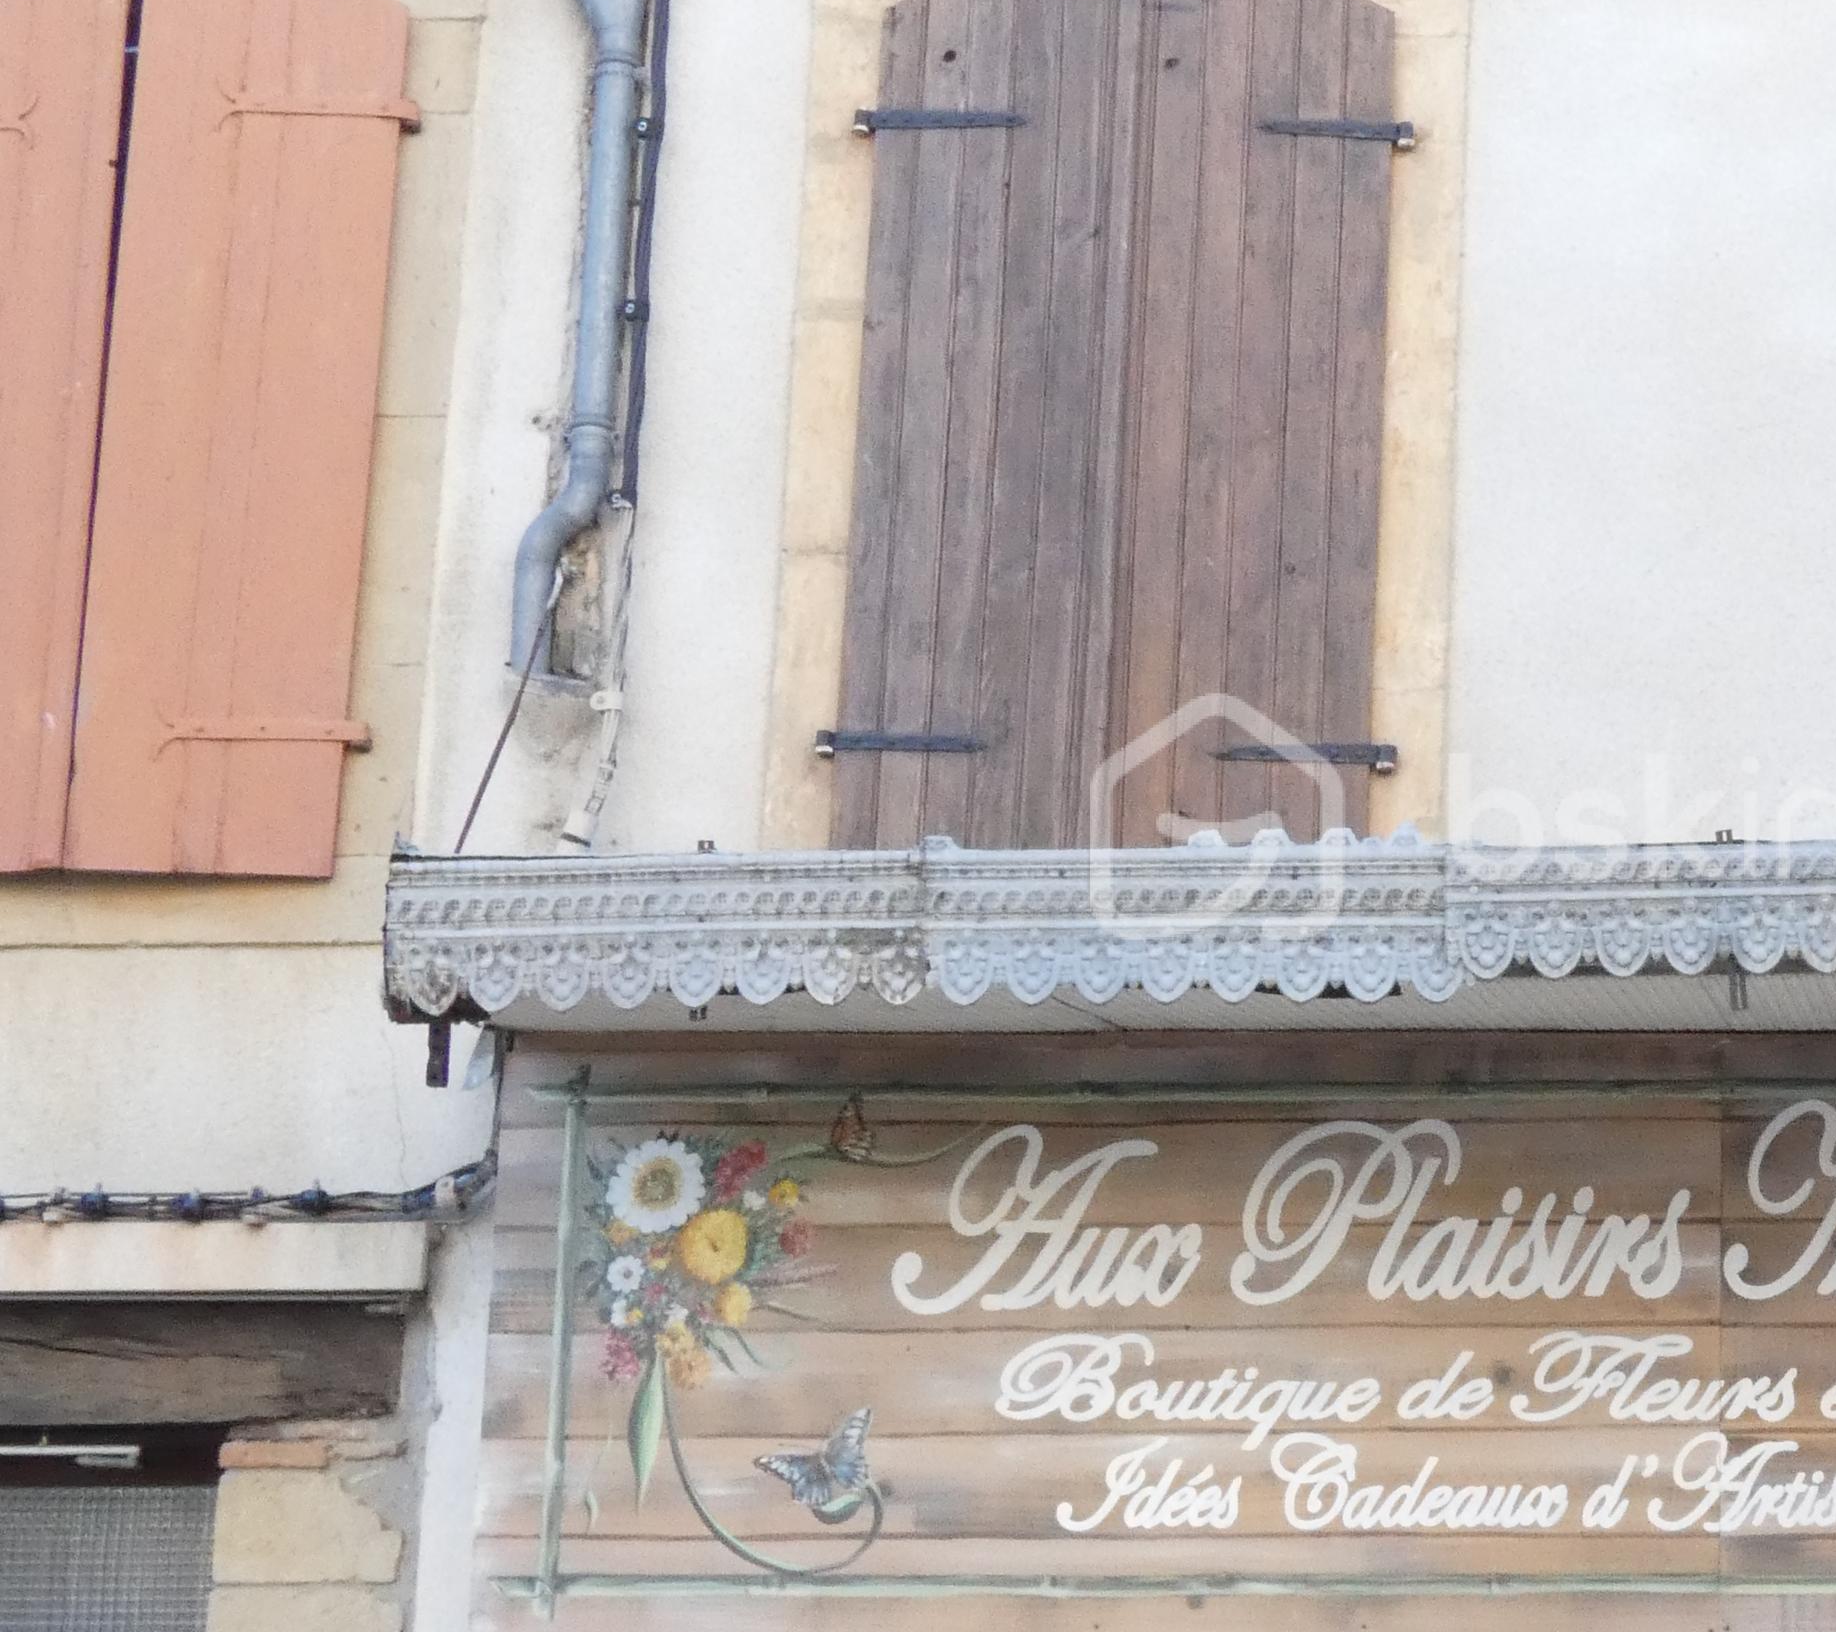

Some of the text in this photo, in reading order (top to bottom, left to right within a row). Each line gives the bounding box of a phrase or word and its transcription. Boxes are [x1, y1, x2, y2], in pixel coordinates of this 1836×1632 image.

[891, 1124, 1202, 1315] Aux
[1230, 1119, 1692, 1306] Plaisirs
[994, 1332, 1381, 1450] Boutique
[1397, 1350, 1495, 1421] de
[1509, 1330, 1798, 1422] Fleurs
[1056, 1436, 1242, 1532] Idées
[1270, 1432, 1567, 1531] Cadeaux
